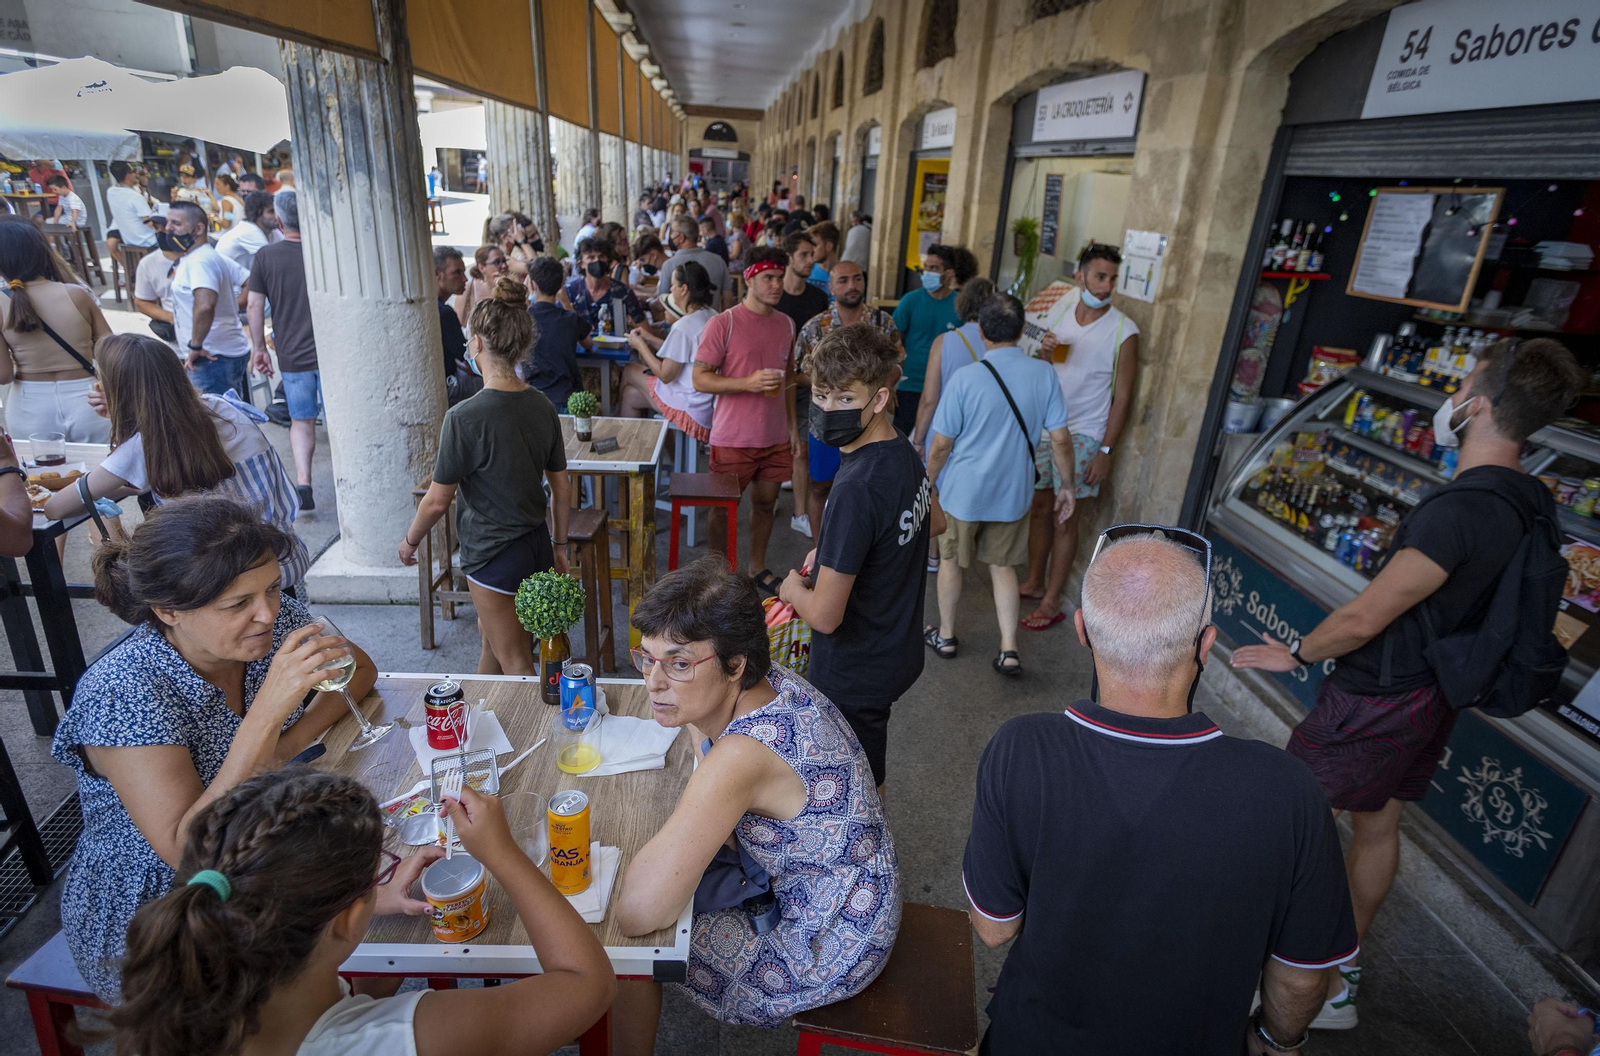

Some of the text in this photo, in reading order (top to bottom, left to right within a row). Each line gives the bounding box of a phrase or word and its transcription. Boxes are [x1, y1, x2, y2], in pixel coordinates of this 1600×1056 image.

[1400, 25, 1434, 63] 54
[1450, 17, 1581, 65] Sabores
[1386, 65, 1431, 80] COMIDA DE
[1386, 80, 1421, 93] BÉLGICA
[1245, 590, 1304, 646] Sabor
[1488, 786, 1515, 824] SB
